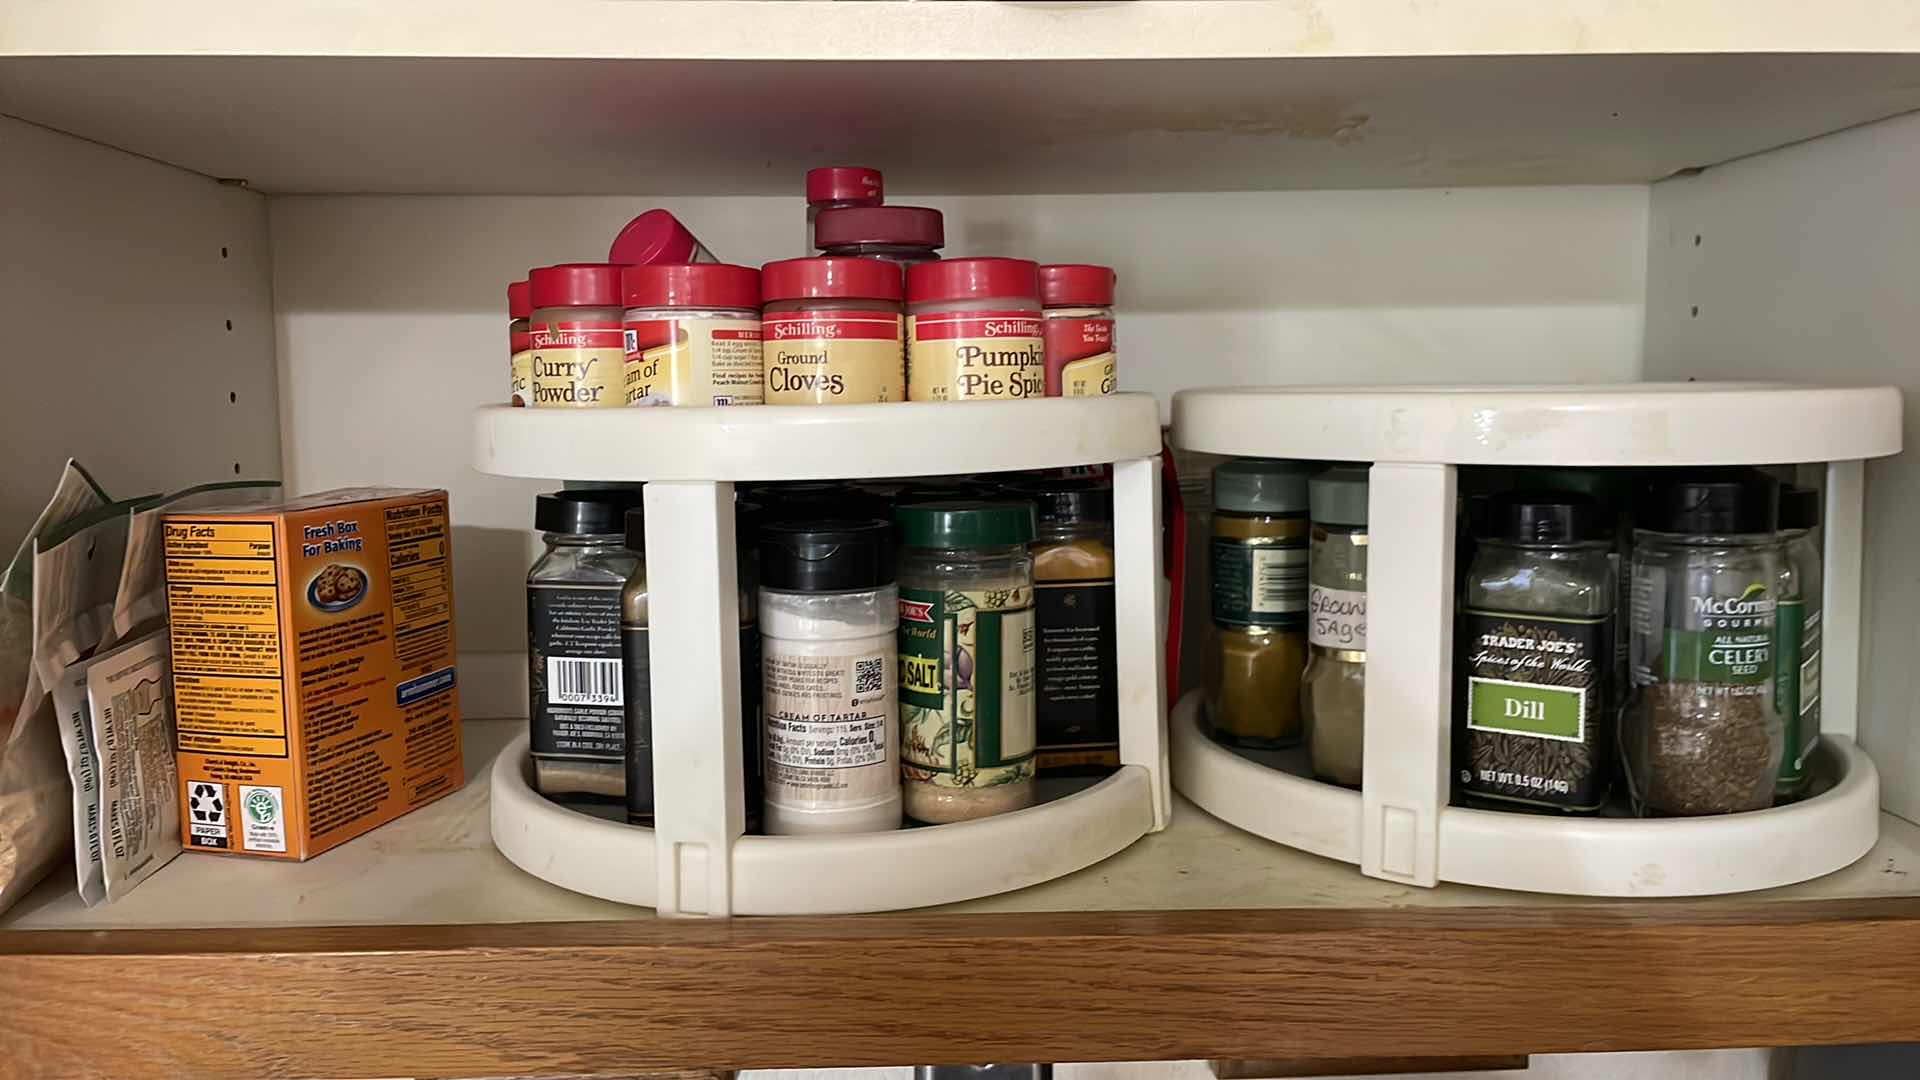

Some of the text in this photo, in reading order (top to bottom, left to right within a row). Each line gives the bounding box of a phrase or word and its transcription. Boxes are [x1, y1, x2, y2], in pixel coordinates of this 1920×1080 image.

[774, 322, 837, 339] Schilling
[984, 321, 1040, 337] Schilling
[777, 350, 828, 365] Ground
[533, 356, 598, 381] Curry
[643, 359, 660, 378] of
[769, 366, 844, 395] Cloves
[957, 373, 1004, 395] Pie
[533, 381, 604, 402] Powder
[165, 526, 215, 539] Drug Facts
[304, 520, 359, 539] Fresh Box
[303, 537, 363, 558] For Baking
[911, 627, 937, 639] World
[1715, 636, 1733, 644] ALL
[1481, 634, 1577, 654] TRADER JOE'S
[1472, 650, 1592, 672] Spices of the World
[907, 661, 936, 688] SALT
[1731, 665, 1758, 675] SEED
[562, 694, 586, 702] 0007
[779, 712, 867, 722] CREAM OF TARTAR
[1504, 697, 1545, 720] Dill
[788, 722, 807, 733] Facts
[840, 737, 867, 746] Calories
[1480, 770, 1496, 782] NET
[1498, 772, 1514, 784] WT.
[1530, 777, 1543, 788] OZ
[195, 826, 221, 835] PAPER
[200, 837, 218, 846] BOX
